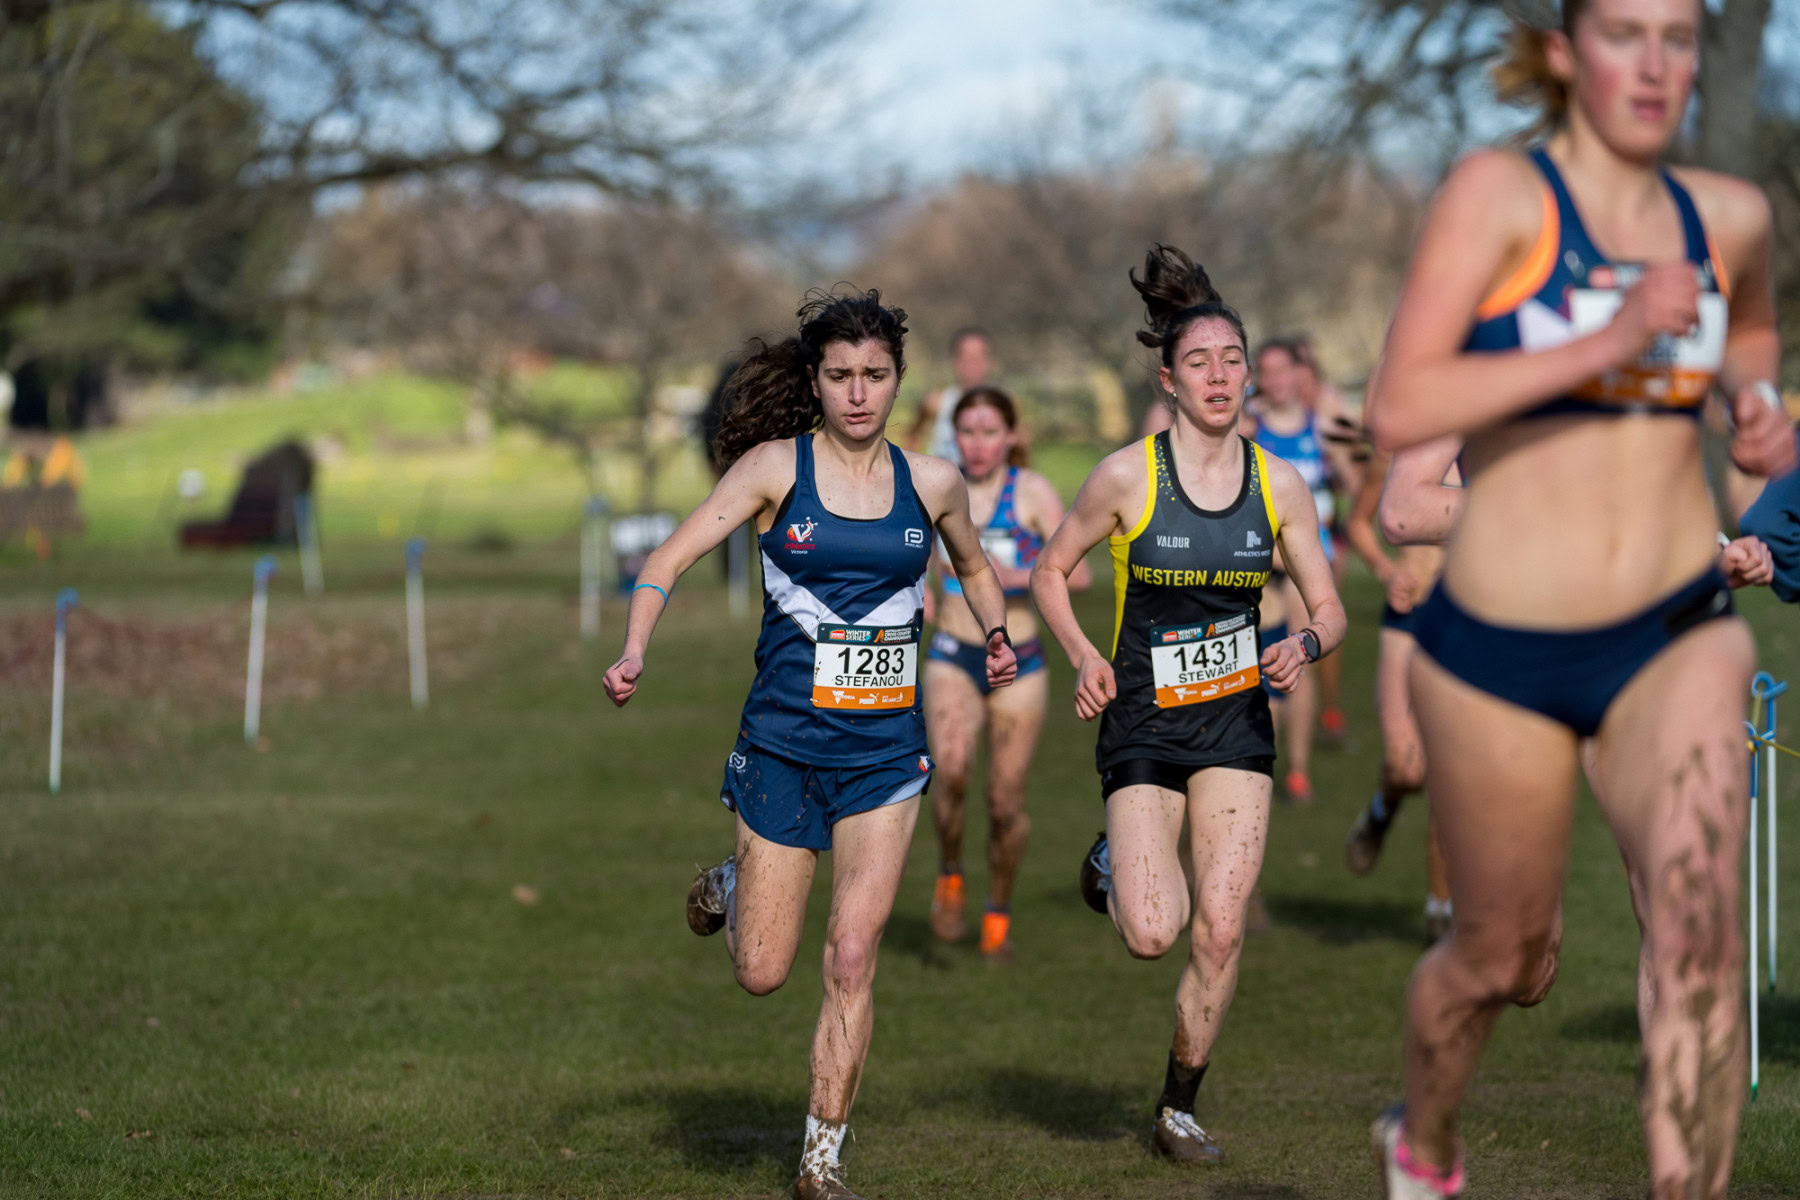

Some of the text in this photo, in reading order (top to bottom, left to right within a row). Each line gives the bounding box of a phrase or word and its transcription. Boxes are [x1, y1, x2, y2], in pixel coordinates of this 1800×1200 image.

[784, 542, 816, 550] Athletics
[1156, 535, 1190, 549] VALOUR
[1131, 564, 1207, 586] WESTERN
[837, 647, 905, 675] 1283
[1173, 633, 1238, 672] 1431
[834, 675, 903, 687] STEFANOU
[1178, 660, 1239, 683] STEWART
